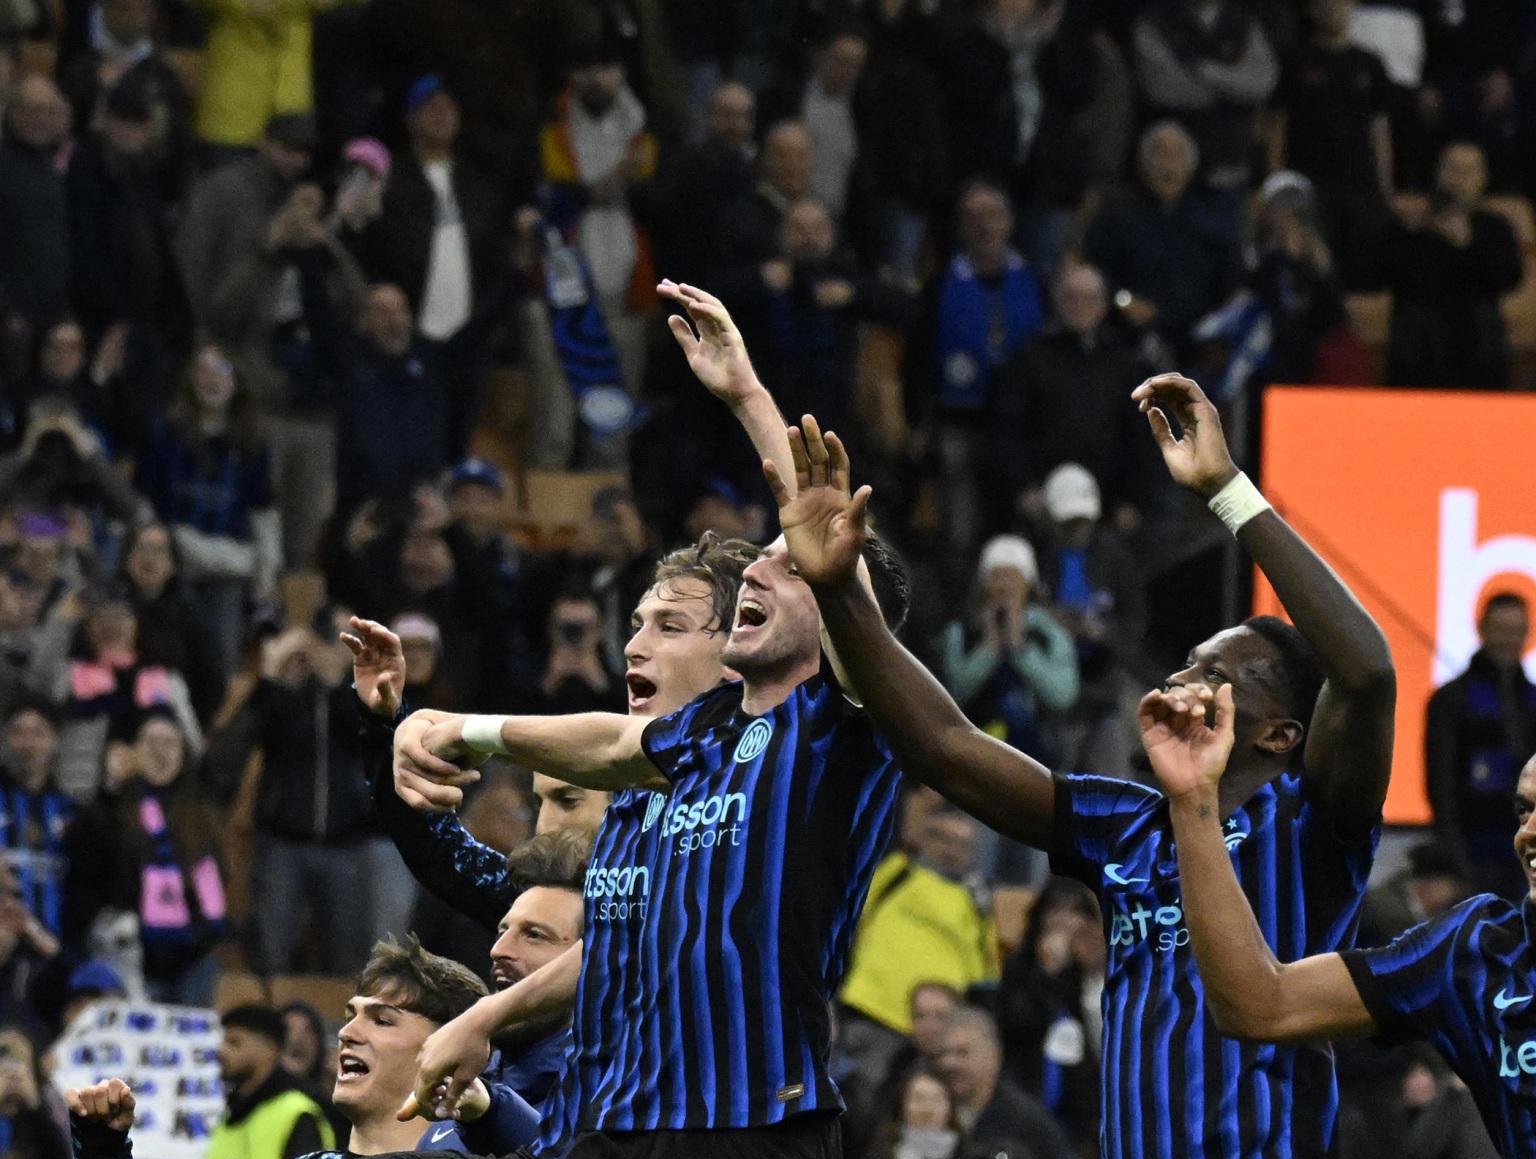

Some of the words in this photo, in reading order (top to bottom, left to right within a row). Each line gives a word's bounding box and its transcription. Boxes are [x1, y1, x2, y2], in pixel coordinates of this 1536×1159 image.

[673, 823, 742, 858] .sport
[583, 858, 650, 898] tsson
[595, 898, 647, 924] .sport
[1155, 928, 1190, 953] .sp
